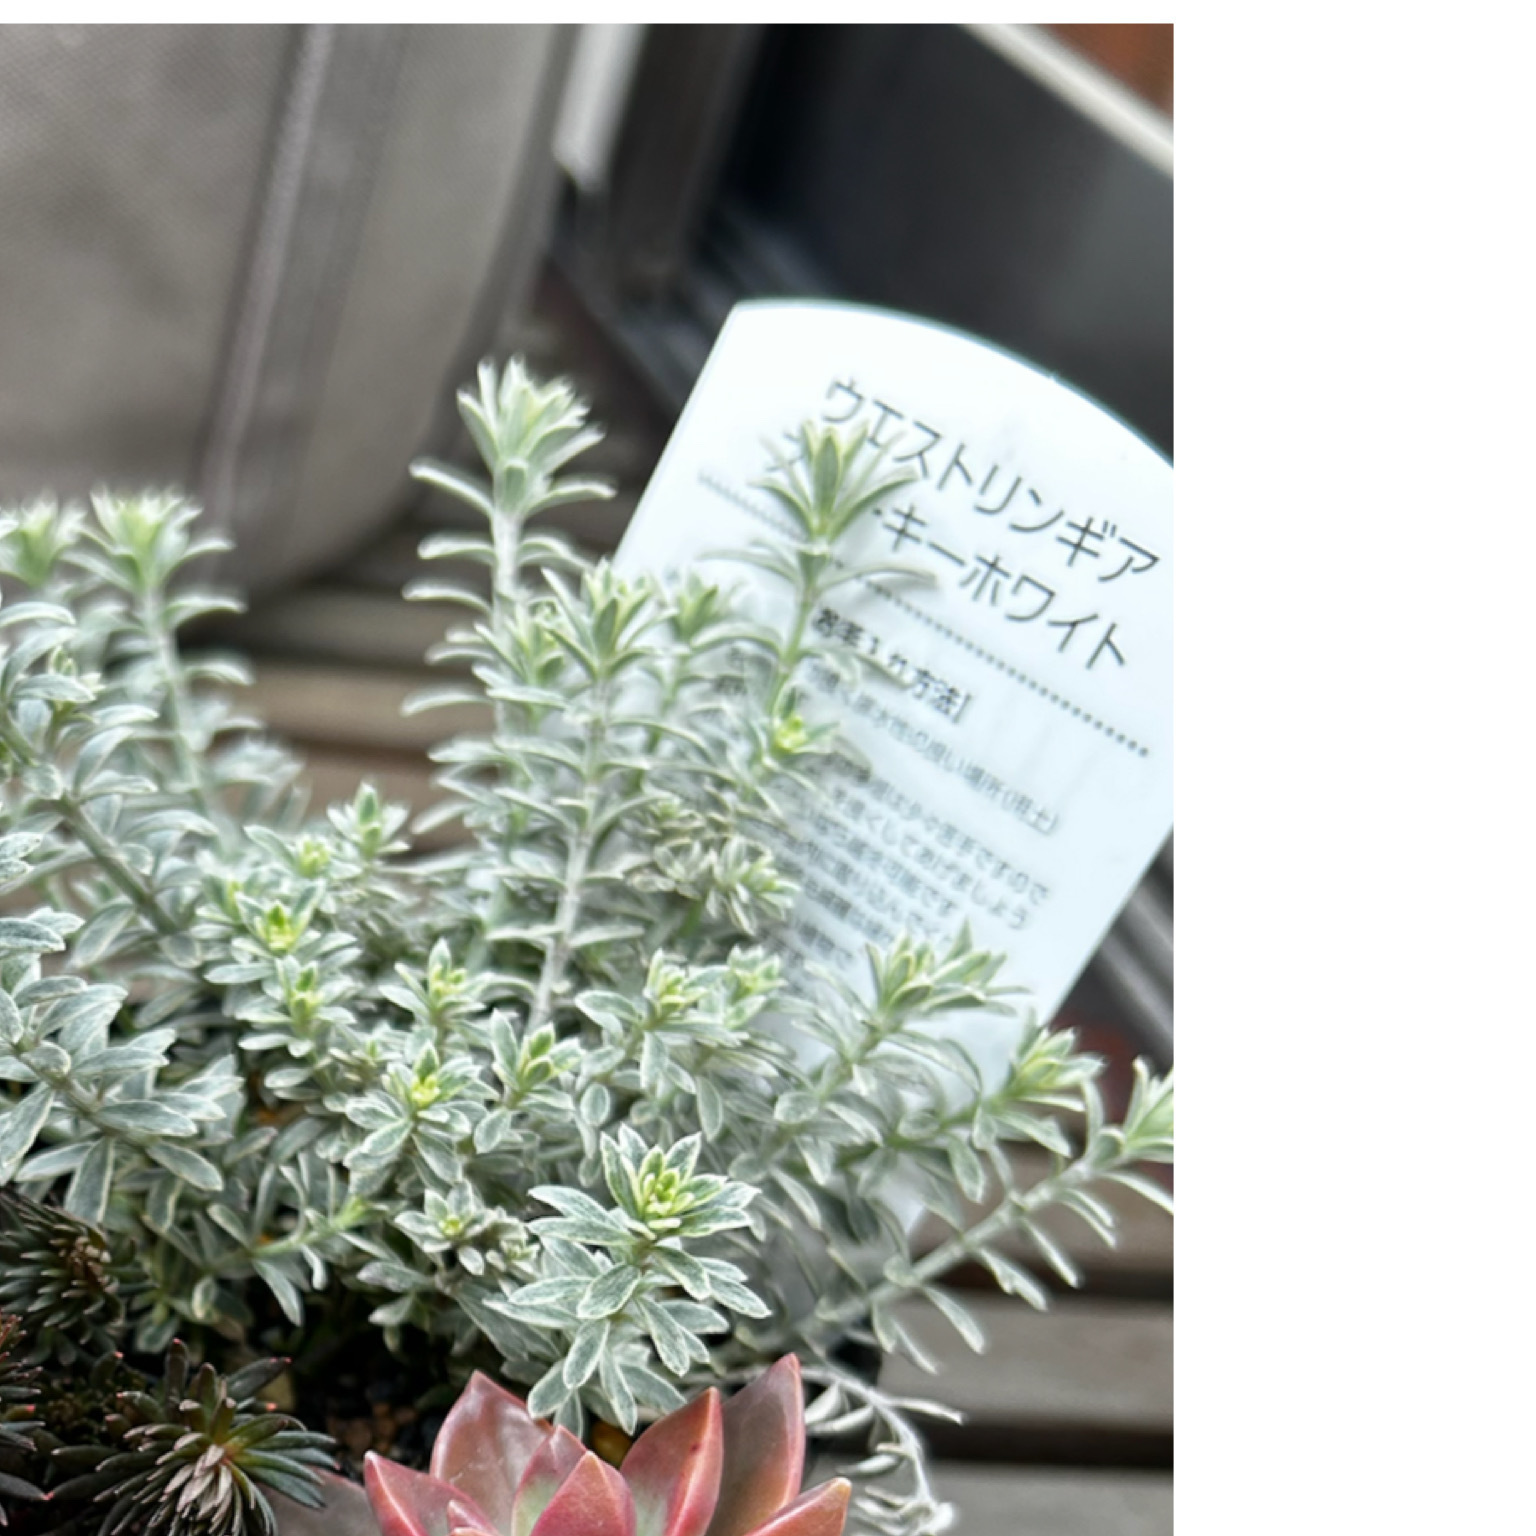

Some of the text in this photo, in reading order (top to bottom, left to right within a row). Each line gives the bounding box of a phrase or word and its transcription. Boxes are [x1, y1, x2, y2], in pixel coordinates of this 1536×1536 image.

[822, 376, 1160, 581] ウエストリンギア
